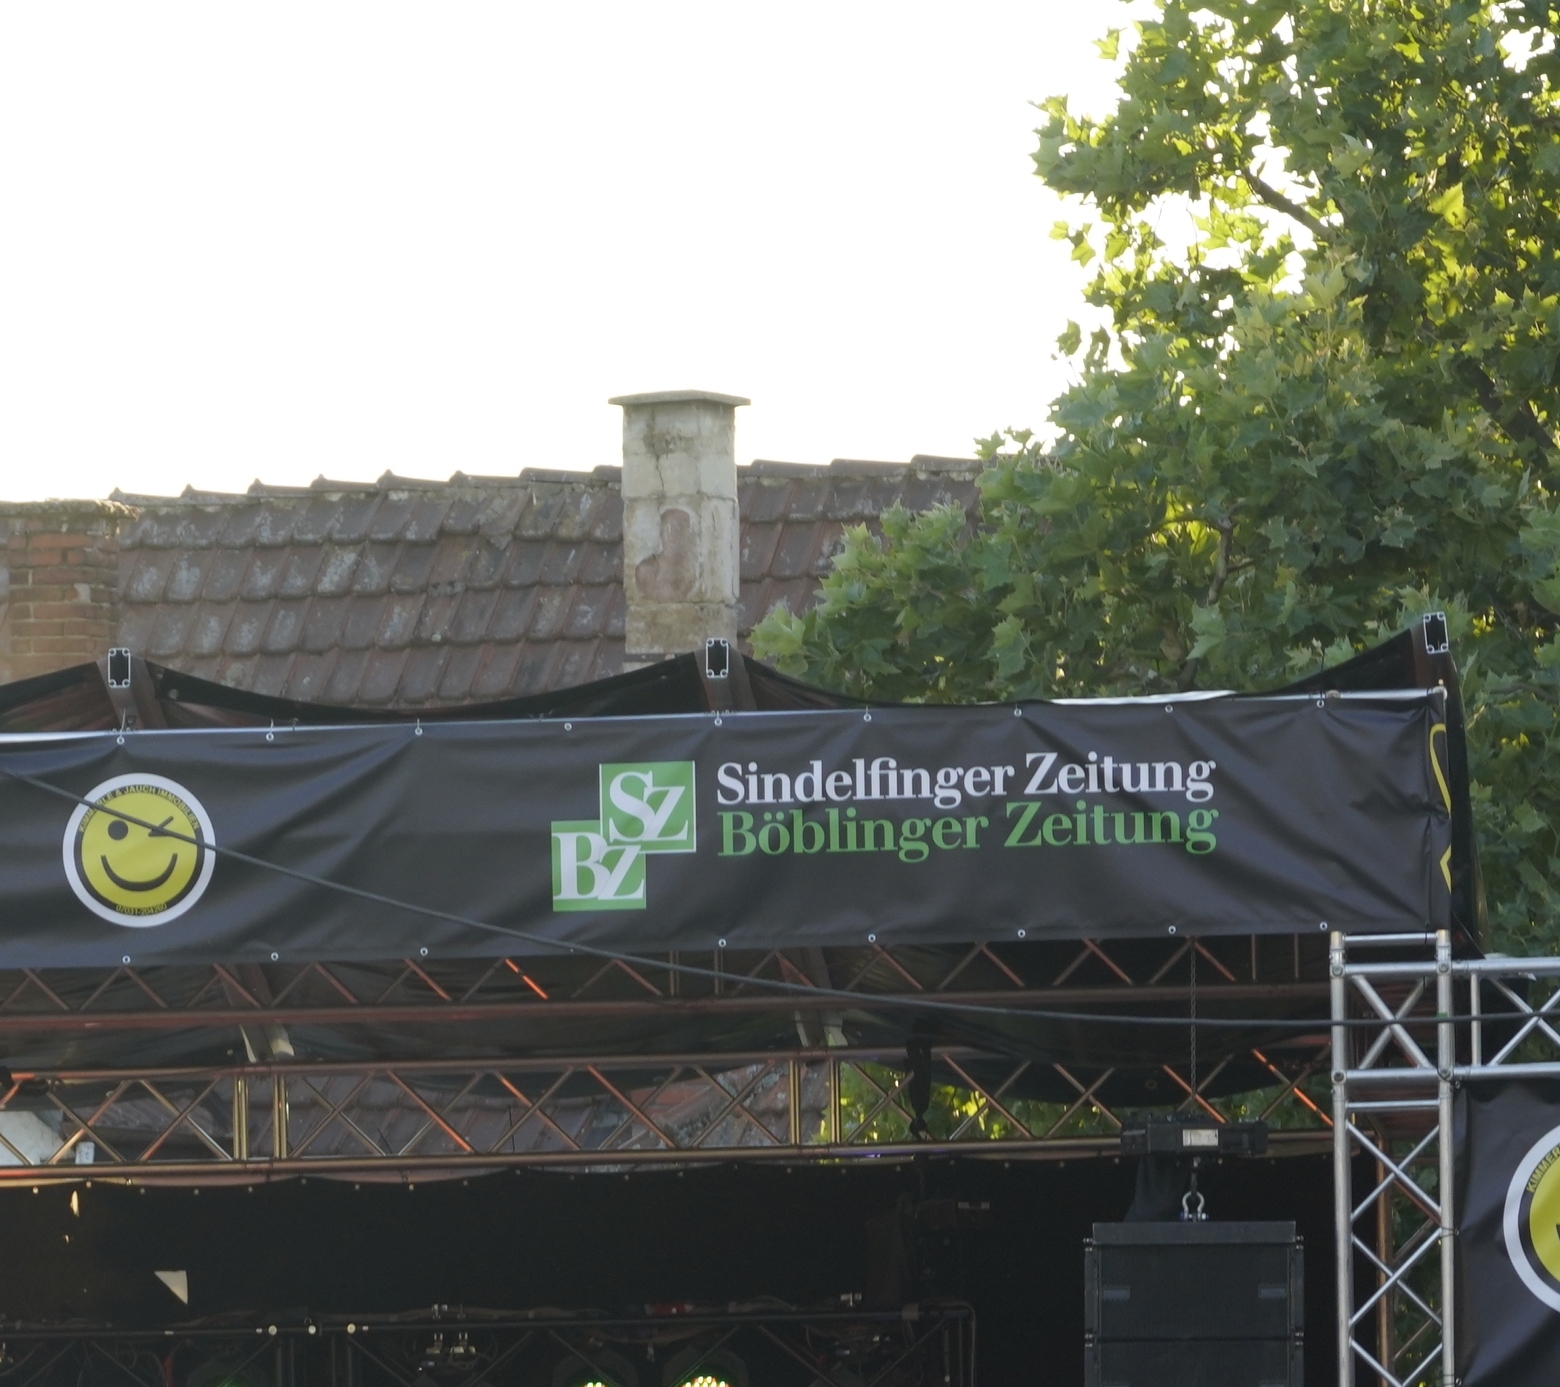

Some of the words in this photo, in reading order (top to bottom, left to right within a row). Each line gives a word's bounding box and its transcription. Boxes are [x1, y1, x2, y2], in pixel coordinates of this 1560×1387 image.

[124, 785, 155, 794] JAUCH
[157, 787, 199, 830] IMMOBILIEN
[608, 771, 689, 843] SZ
[717, 757, 1015, 809] Sindelfinger
[1024, 751, 1216, 802] Zeitung
[717, 807, 989, 863] Böblinger
[1003, 800, 1220, 854] Zeitung
[552, 831, 645, 900] BZ
